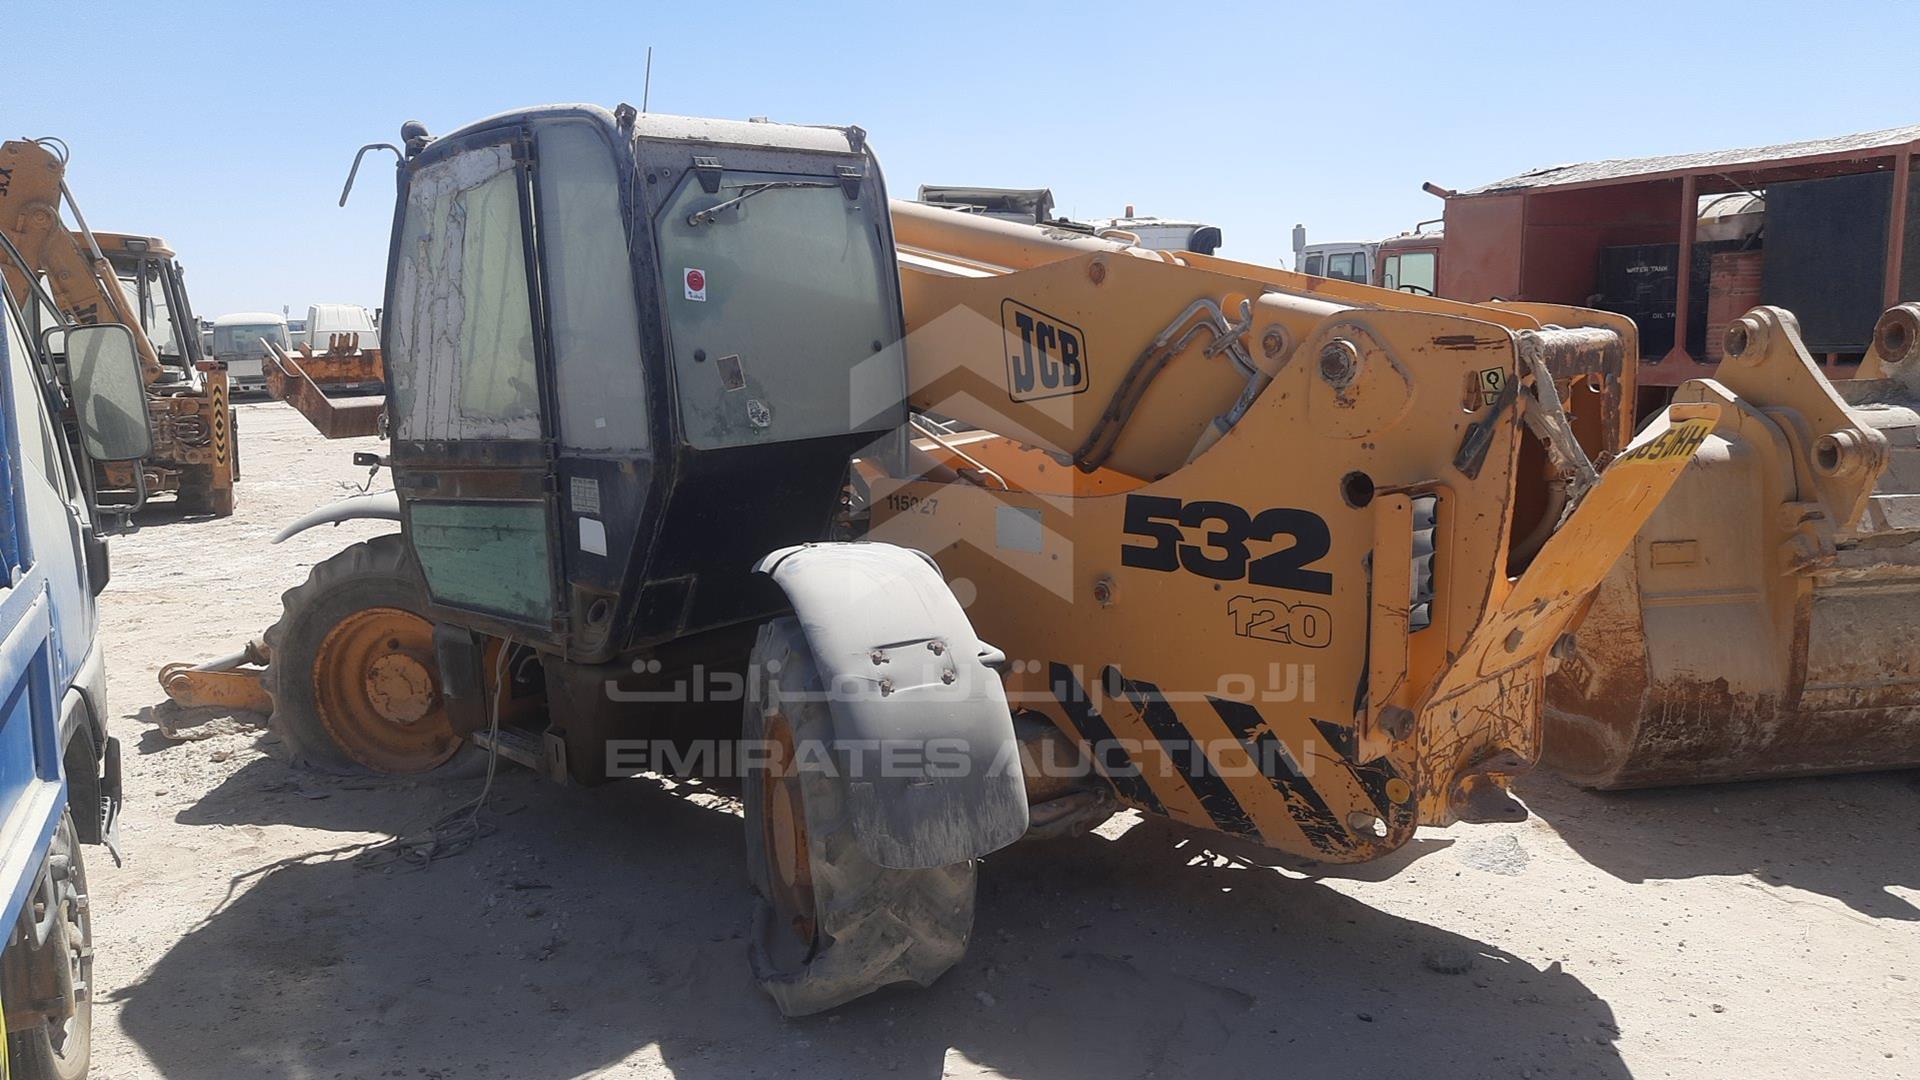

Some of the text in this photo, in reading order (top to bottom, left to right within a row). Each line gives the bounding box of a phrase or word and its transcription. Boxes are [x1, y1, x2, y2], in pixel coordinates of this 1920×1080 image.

[1012, 310, 1082, 394] JCB
[1121, 494, 1333, 595] 532
[1227, 595, 1333, 649] 120
